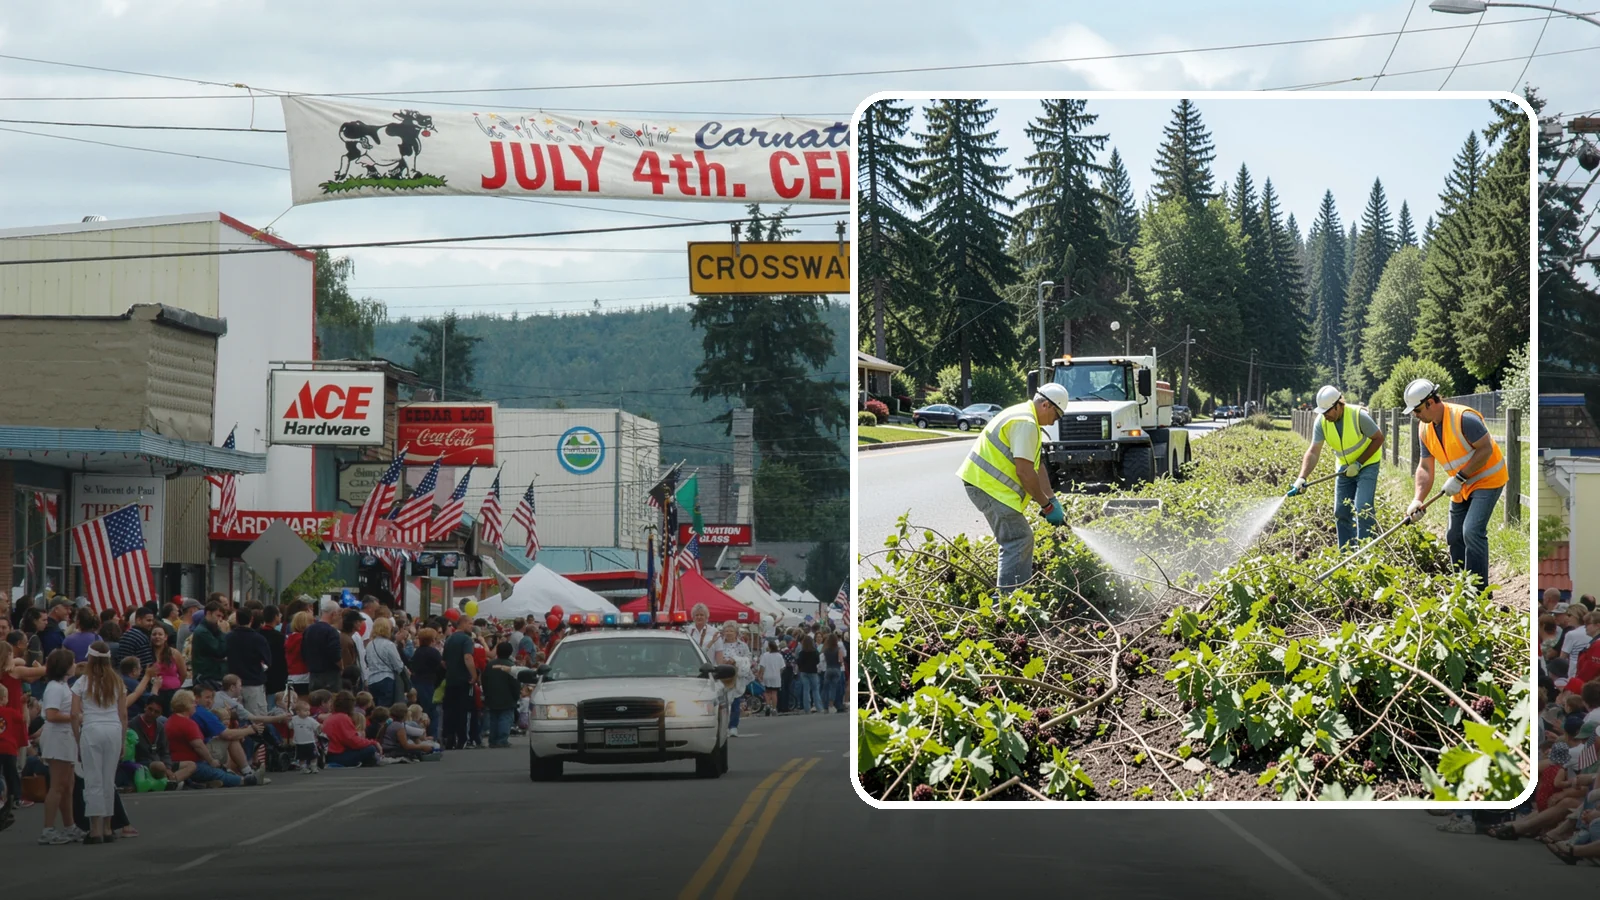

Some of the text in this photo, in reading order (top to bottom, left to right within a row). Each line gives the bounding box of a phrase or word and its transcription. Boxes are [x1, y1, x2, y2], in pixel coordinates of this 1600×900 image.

[695, 121, 850, 149] Carnat
[481, 141, 604, 192] JULY
[632, 150, 746, 198] 4th.
[697, 254, 850, 279] CROSSWA
[283, 380, 373, 420] ACE
[406, 409, 453, 422] CEDAR
[284, 421, 370, 436] Hardware
[416, 428, 477, 447] Coca-Cola
[353, 467, 386, 479] Simpl
[83, 484, 155, 495] St. Vincent de Paul
[687, 526, 741, 535] CRNATION
[699, 535, 730, 543] GLASS
